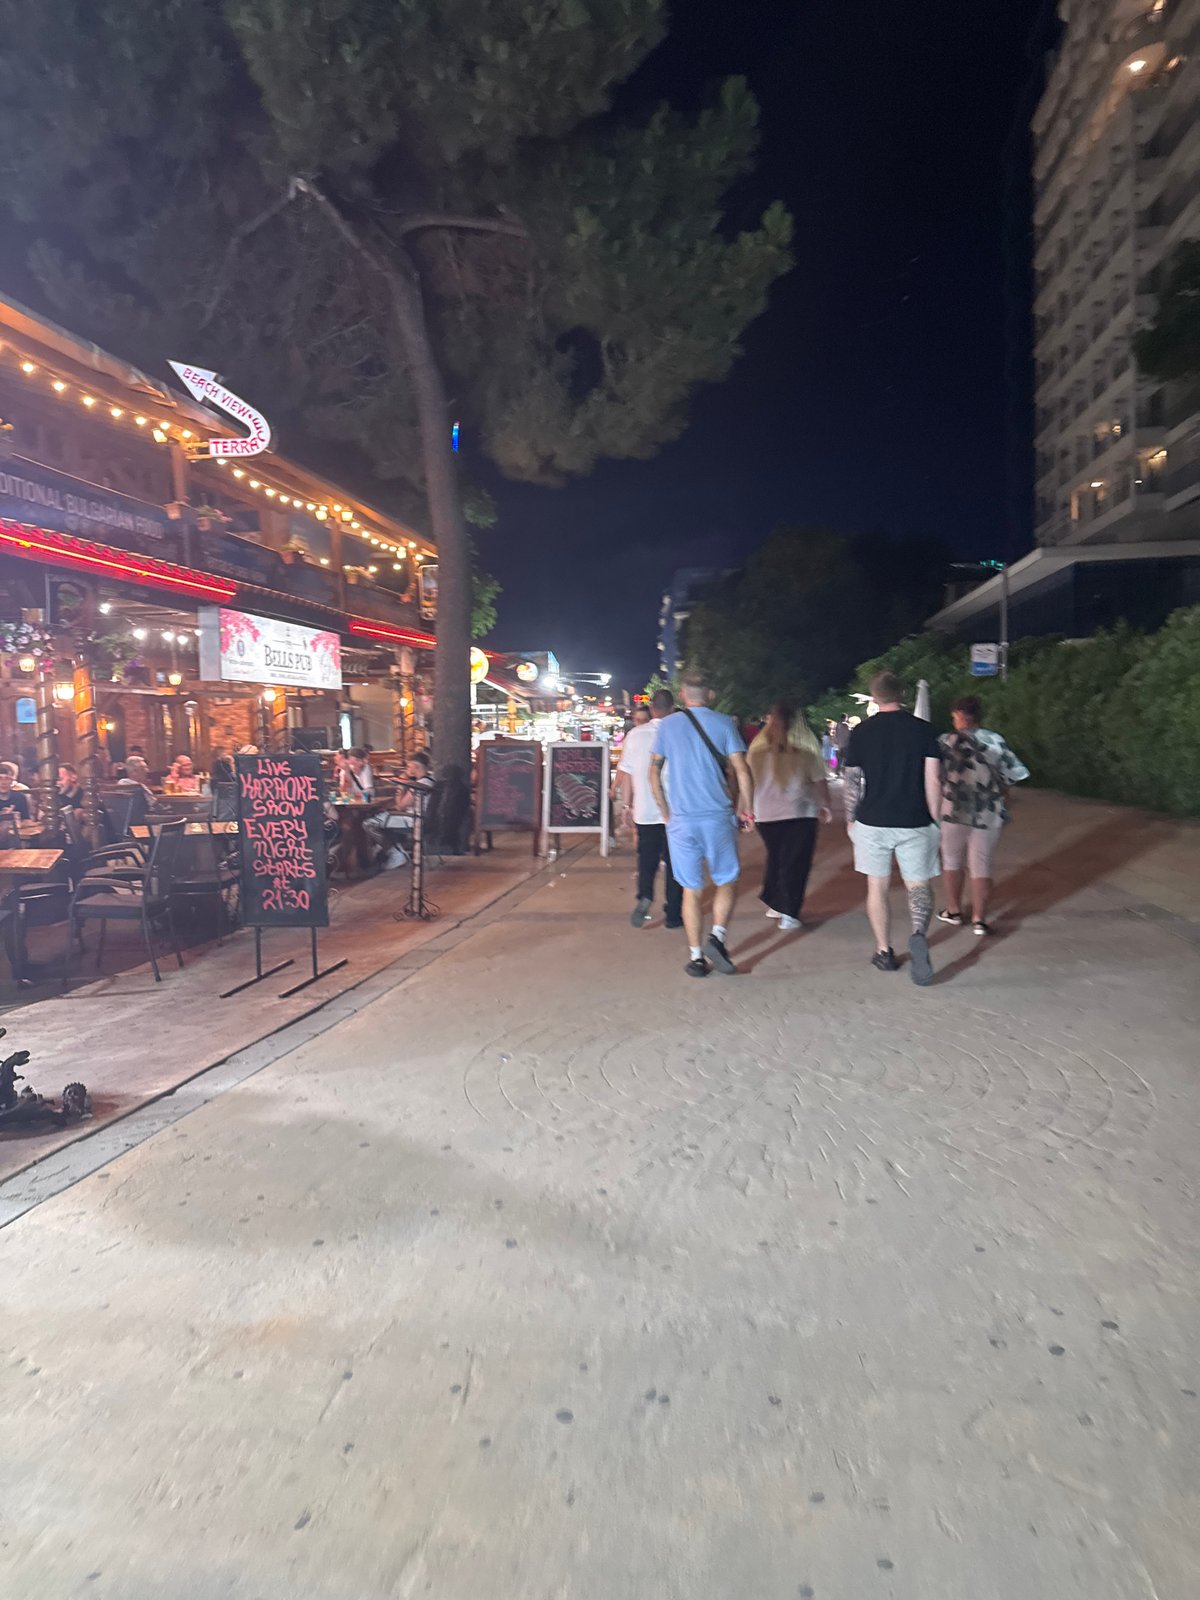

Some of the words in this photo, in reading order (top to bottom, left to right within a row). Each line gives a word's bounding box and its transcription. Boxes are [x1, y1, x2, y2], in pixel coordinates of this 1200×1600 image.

[182, 367, 220, 398] BEACH
[221, 392, 251, 418] VIEW
[239, 773, 320, 803] KARAOKE
[242, 817, 309, 841] EVERY
[261, 889, 311, 911] 21:30
